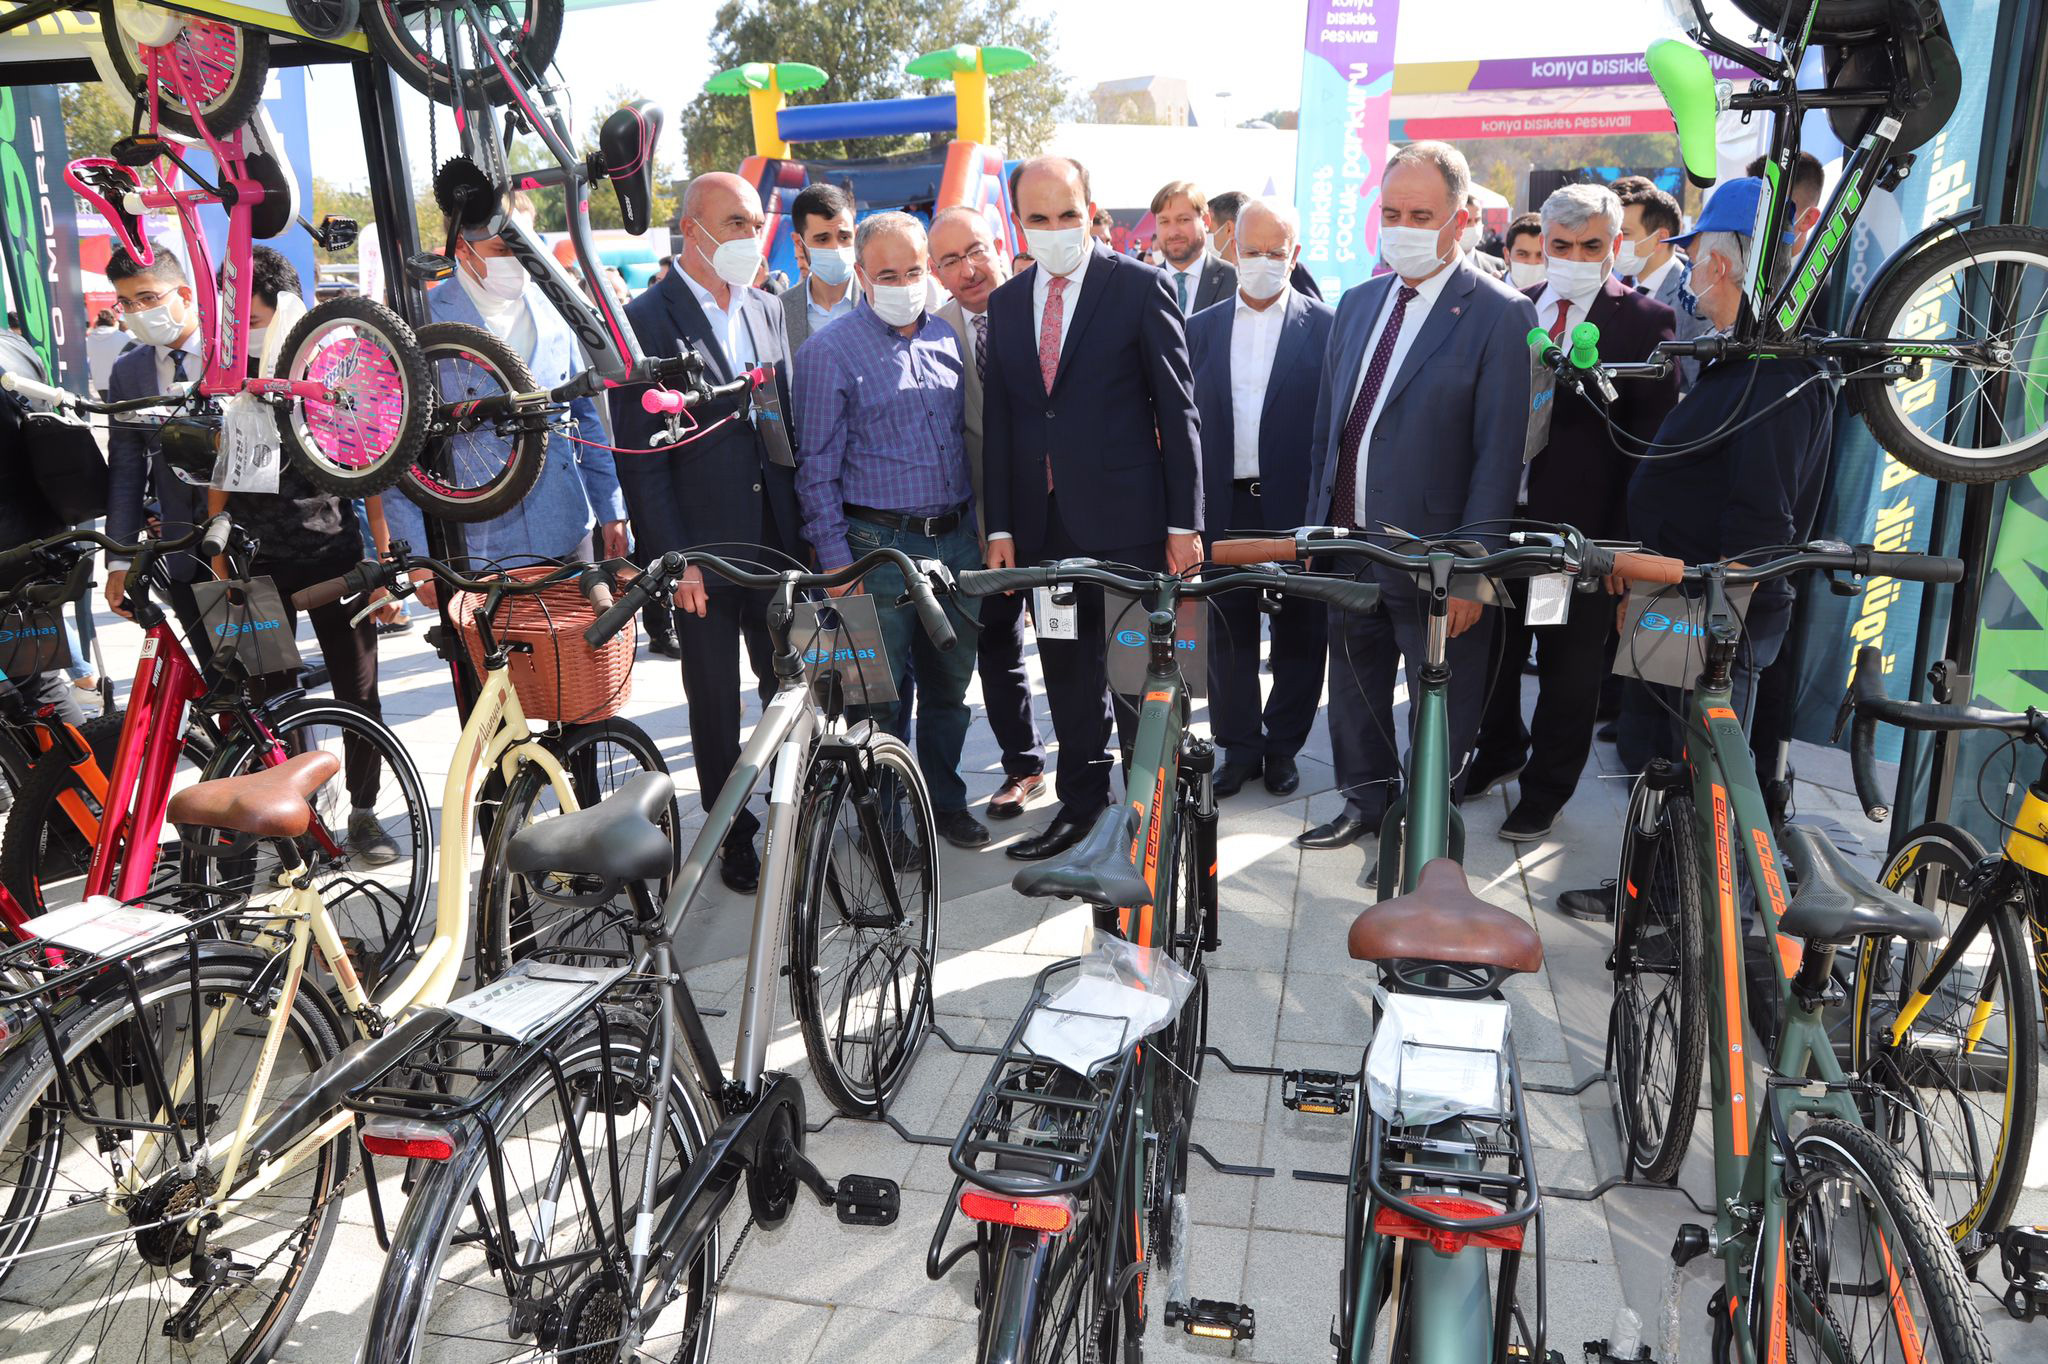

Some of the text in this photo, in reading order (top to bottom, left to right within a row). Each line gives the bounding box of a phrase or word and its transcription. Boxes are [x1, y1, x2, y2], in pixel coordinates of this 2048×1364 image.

[1325, 12, 1377, 25] bisiklet
[1532, 54, 1649, 81] konya bisikle
[1481, 120, 1522, 134] konya
[1523, 117, 1572, 130] bisiklet
[1335, 62, 1369, 263] çocuk parkuru
[1780, 147, 1790, 170] ATB
[30, 115, 59, 282] MORE
[1307, 164, 1334, 262] bisiklet
[499, 226, 606, 350] MOSSO
[410, 462, 453, 497] MOSSO
[1672, 618, 1705, 638] erb
[832, 646, 876, 662] erbaş
[478, 702, 502, 744] Alanya
[1148, 709, 1164, 720] 28
[1722, 725, 1739, 737] 28
